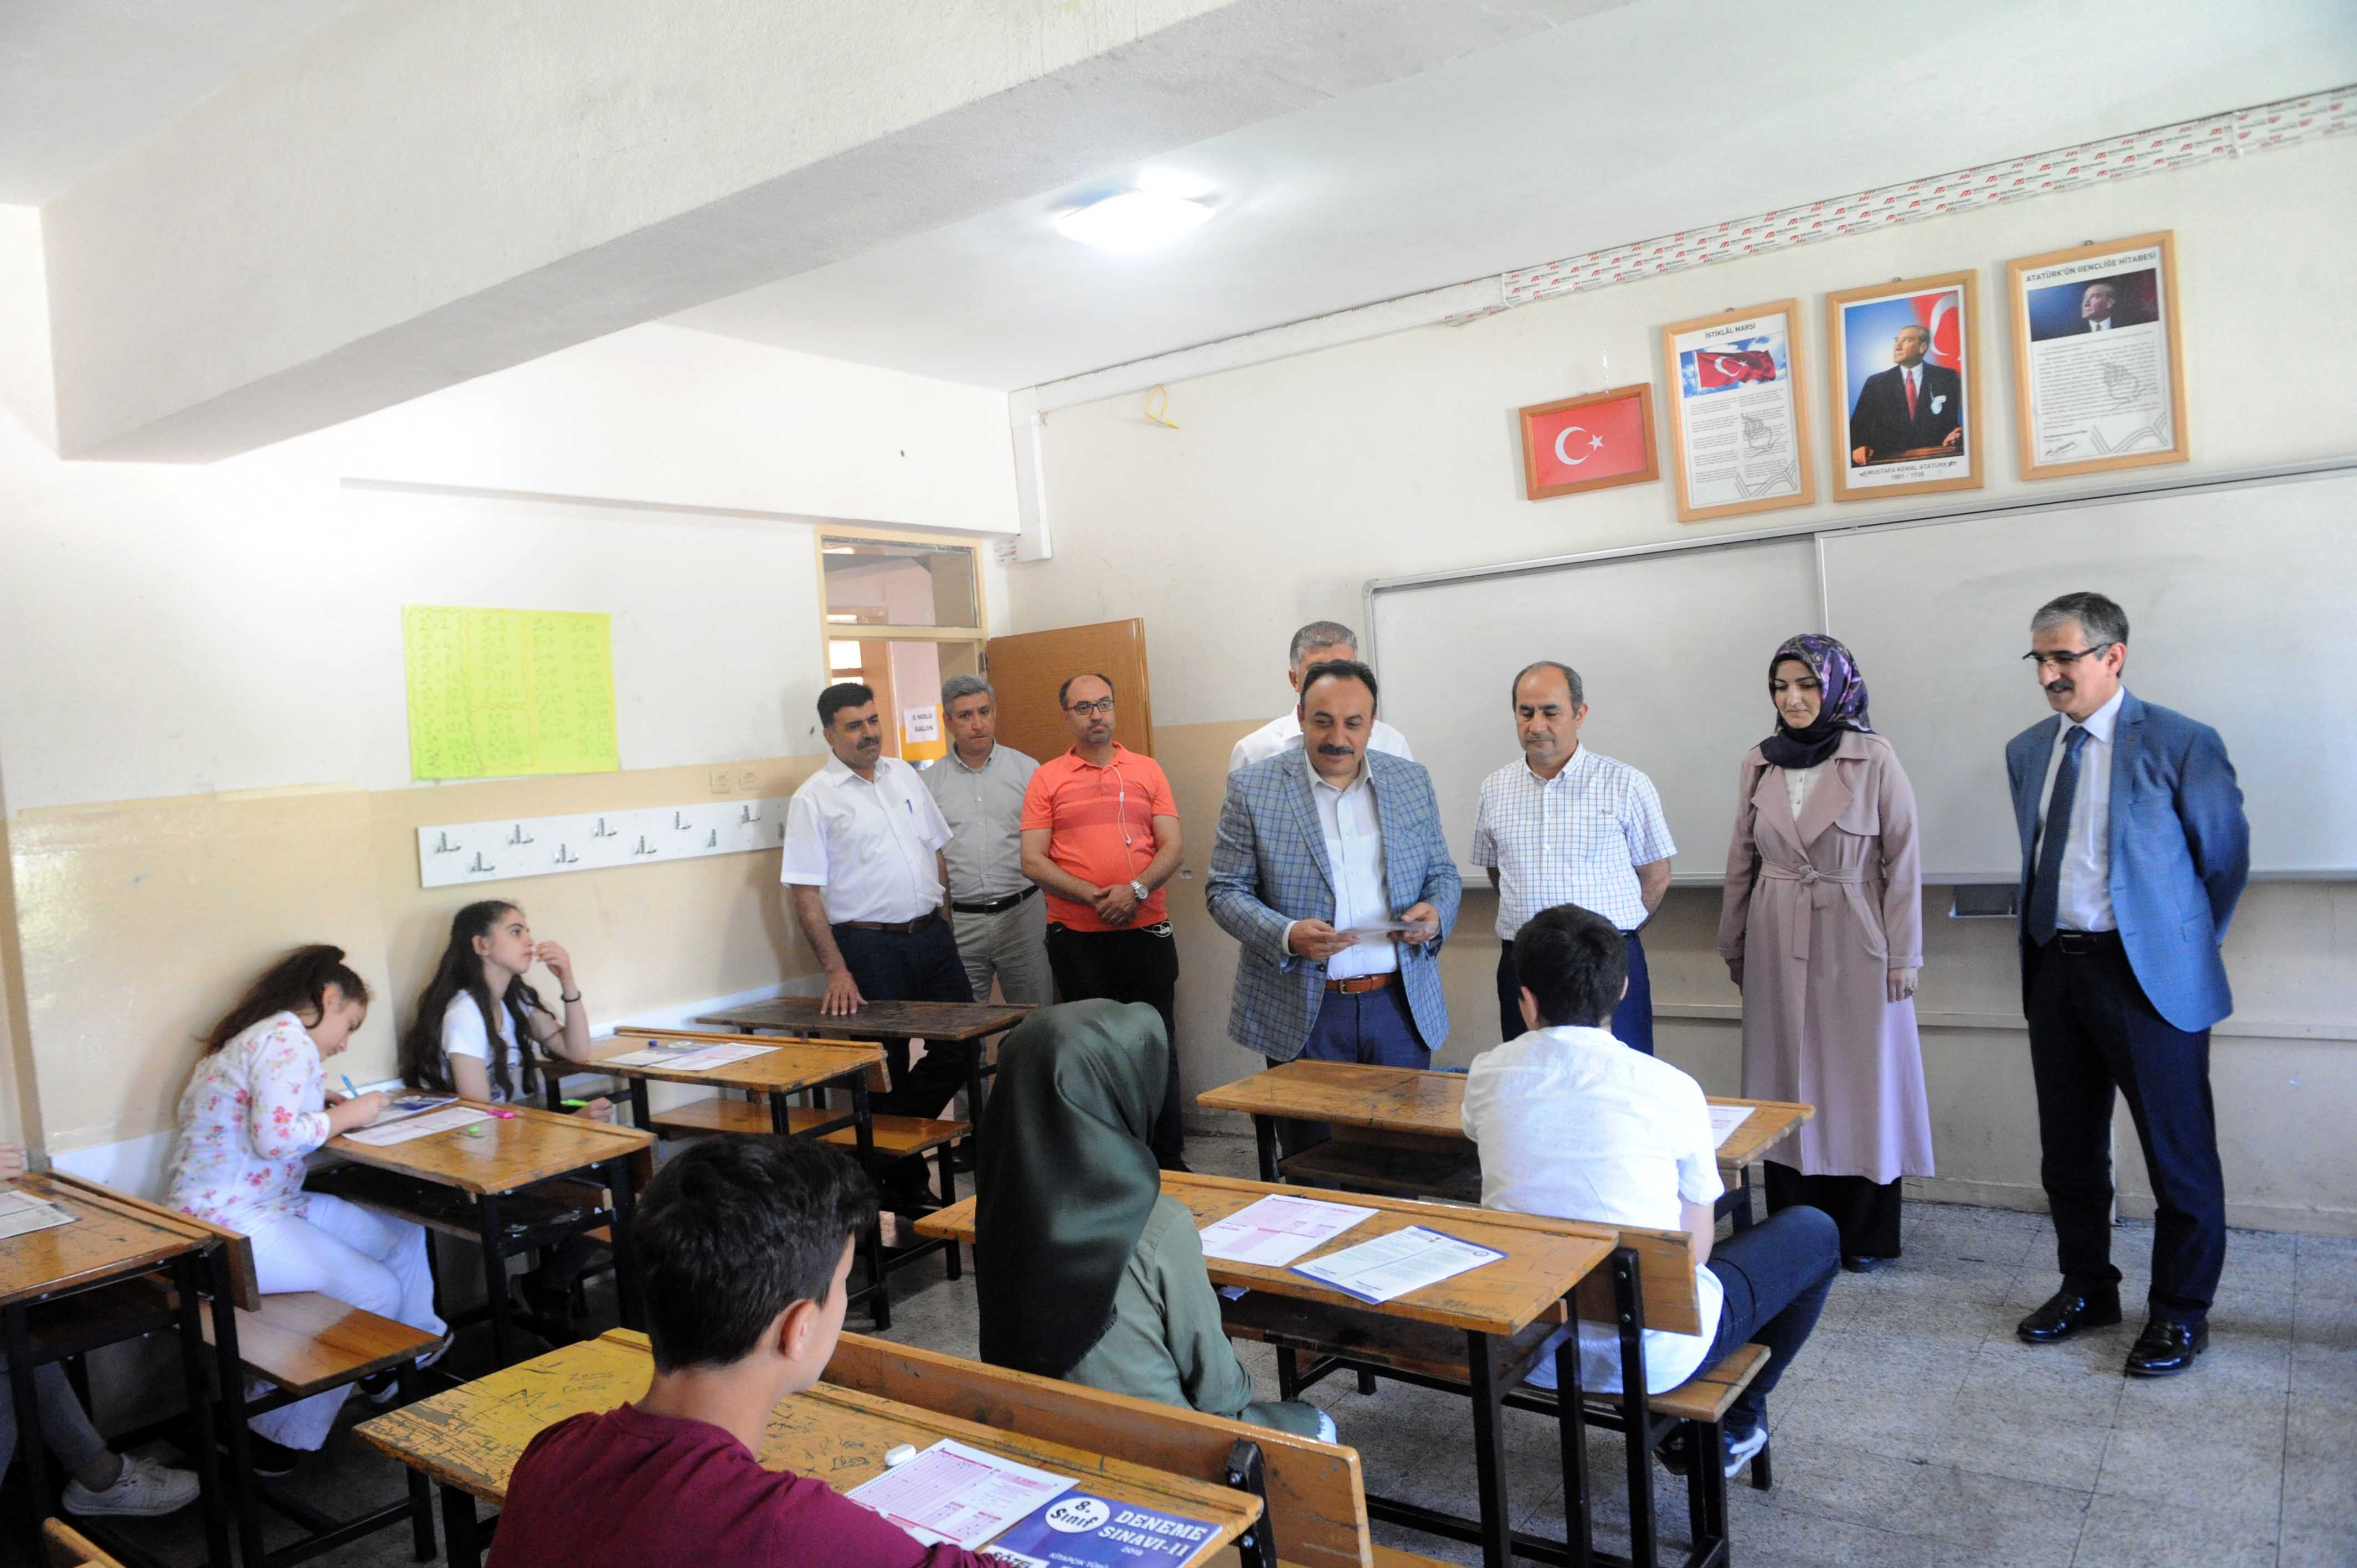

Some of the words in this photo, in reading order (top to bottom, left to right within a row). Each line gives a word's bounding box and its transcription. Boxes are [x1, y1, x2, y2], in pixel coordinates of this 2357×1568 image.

[2026, 266, 2076, 282] ATATÜRK'ÜN
[2119, 251, 2157, 265] HİTABESİ
[1075, 1500, 1092, 1513] 8.
[1098, 1525, 1191, 1557] SINAVI-II
[1114, 1510, 1209, 1542] DENEME
